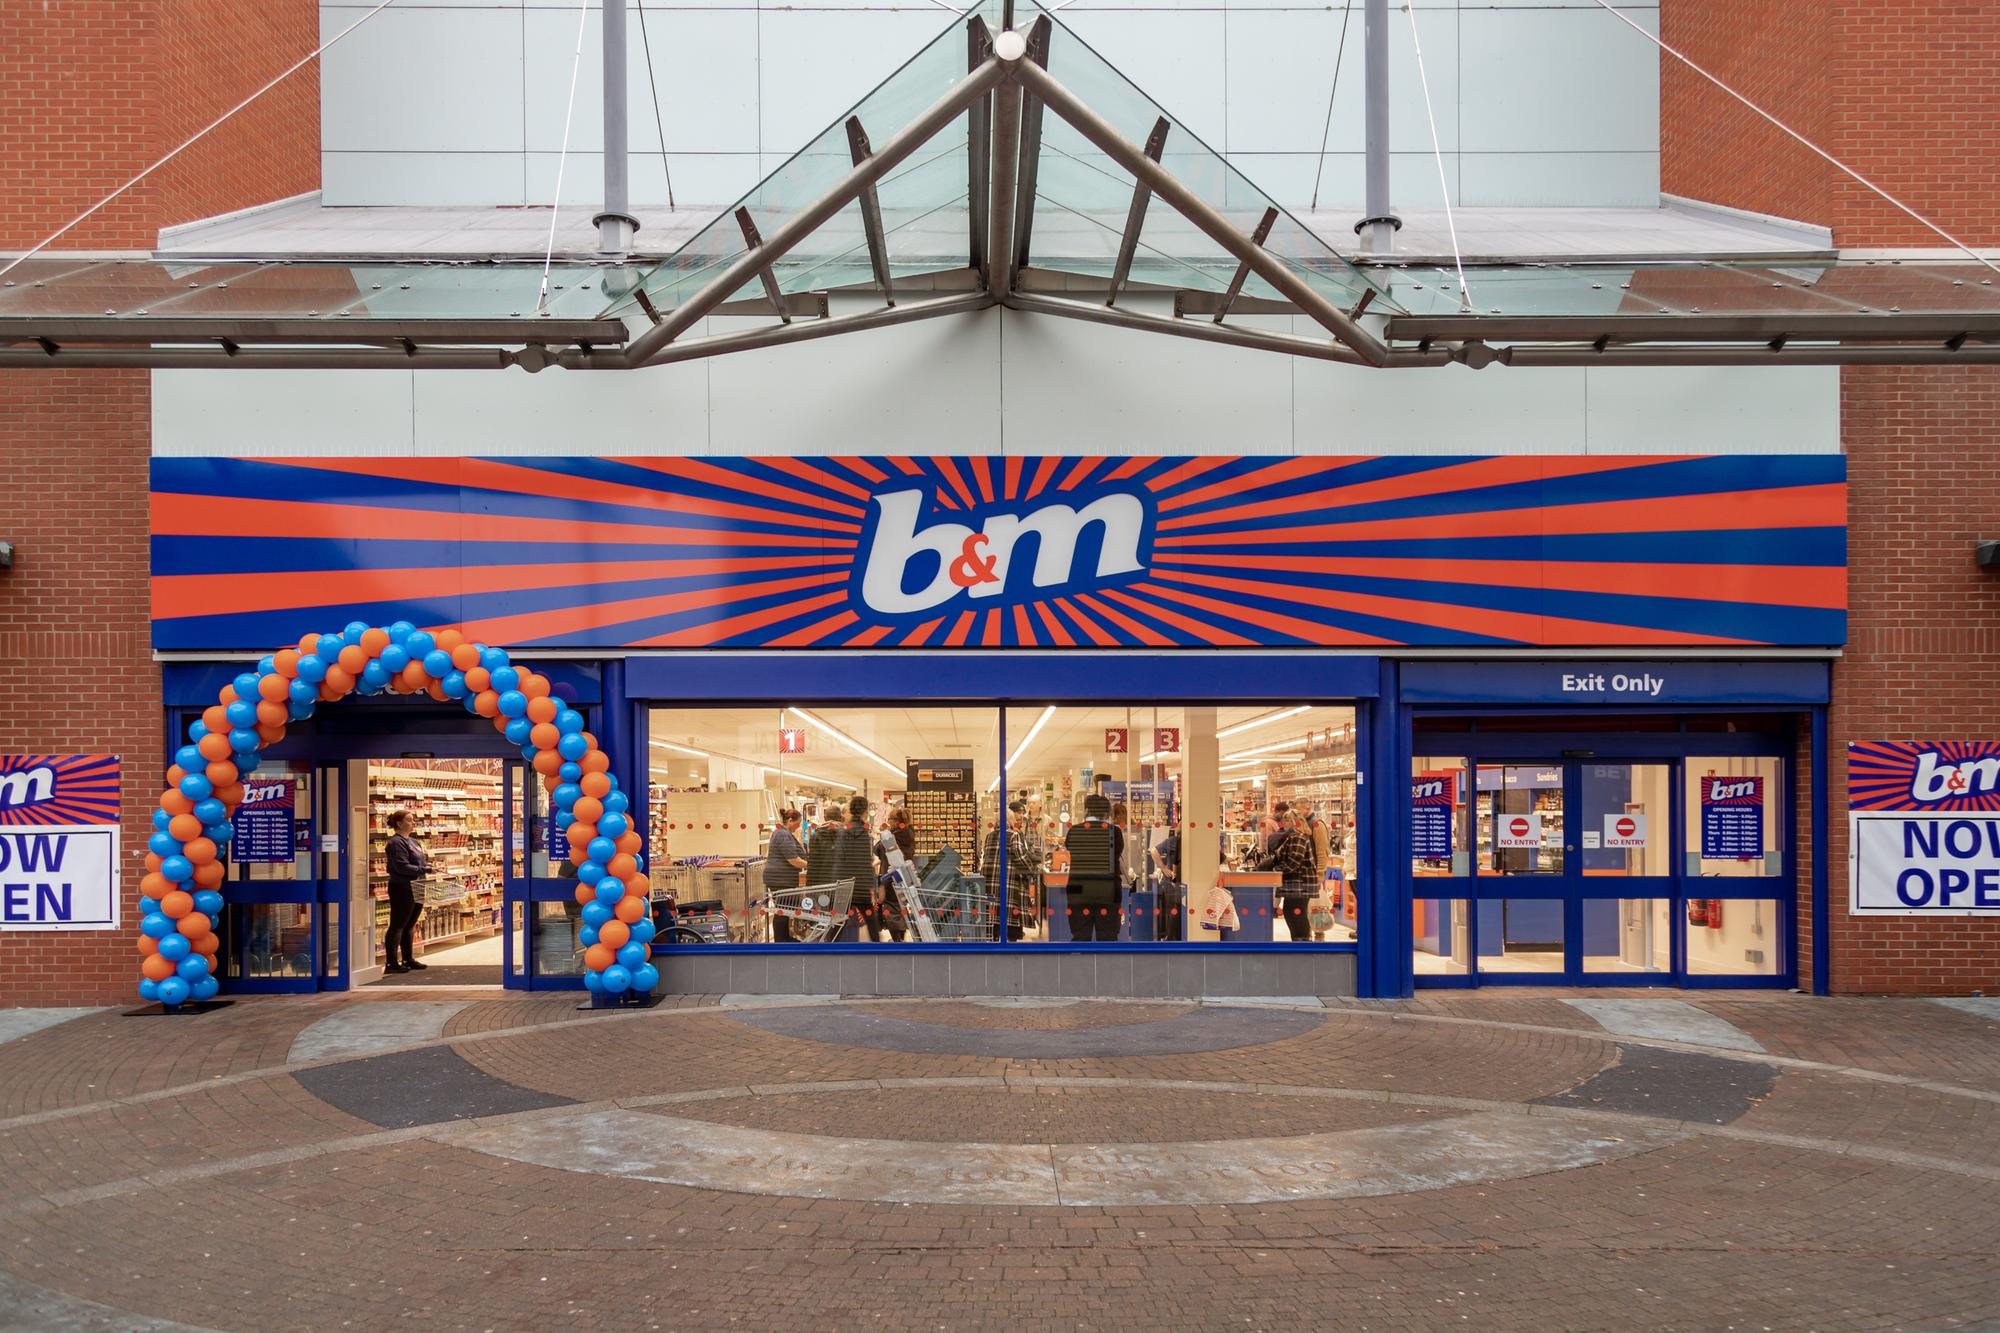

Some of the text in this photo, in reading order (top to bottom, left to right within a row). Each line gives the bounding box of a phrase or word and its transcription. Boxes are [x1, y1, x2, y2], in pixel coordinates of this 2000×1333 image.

[862, 488, 1147, 614] b&m
[1562, 674, 1664, 696] Exit Only
[784, 732, 795, 750] 1
[1108, 732, 1121, 750] 2
[1160, 732, 1174, 750] 3
[1912, 752, 2000, 801] b&m
[241, 784, 285, 804] b&m
[1412, 781, 1442, 798] &m
[1710, 780, 1754, 800] b&m
[1904, 820, 2000, 859] NO
[1897, 868, 2000, 907] OPE
[4, 883, 72, 921] EN
